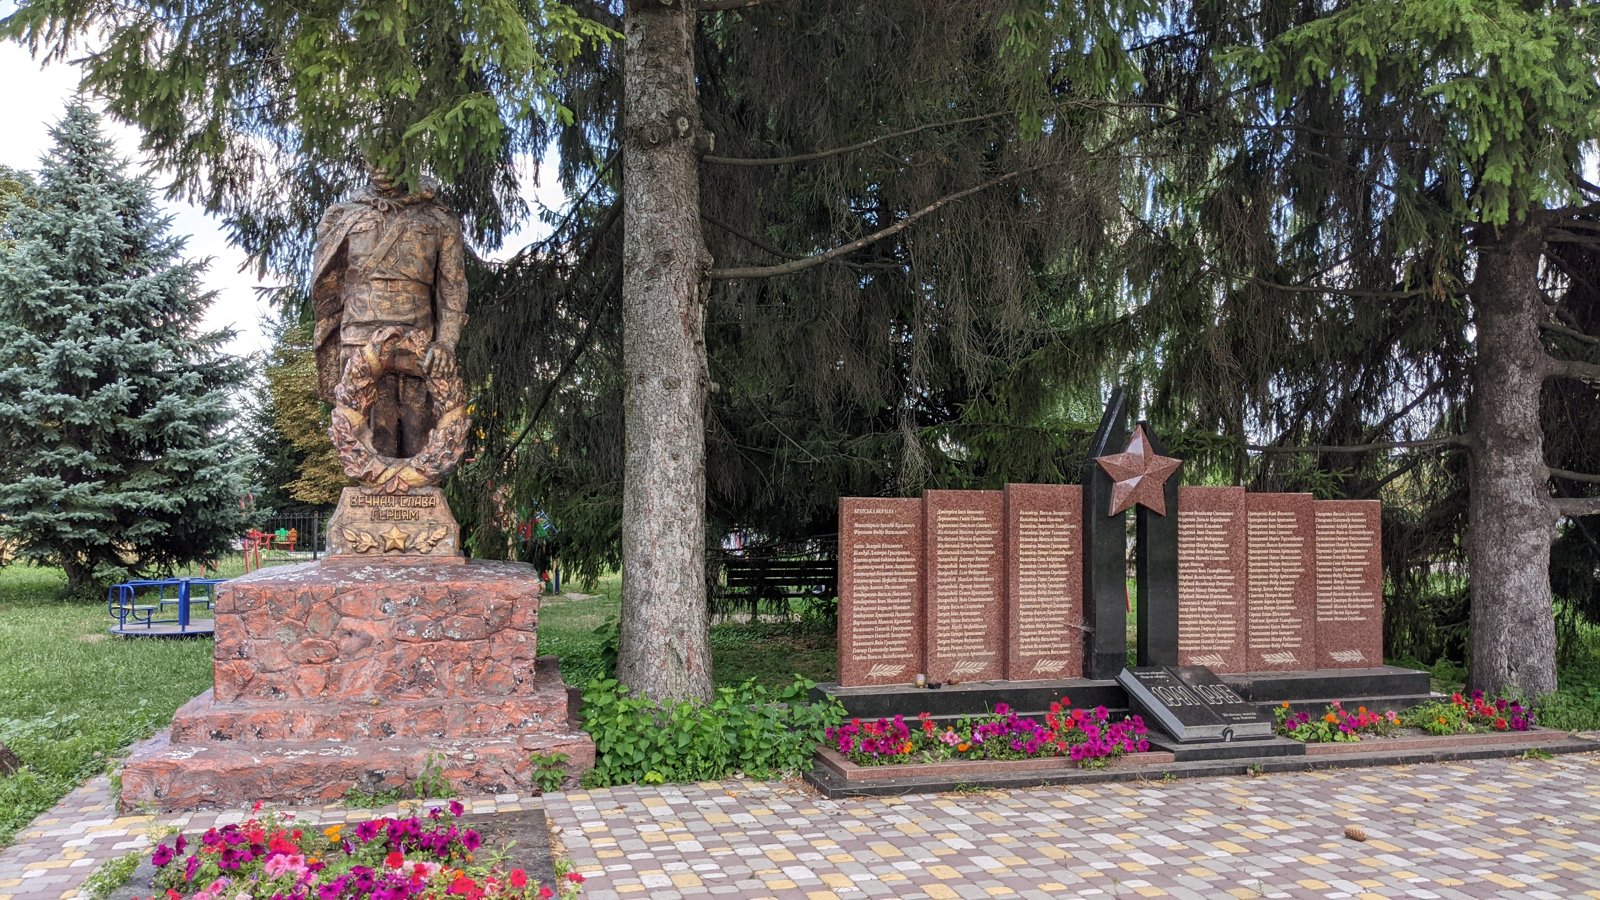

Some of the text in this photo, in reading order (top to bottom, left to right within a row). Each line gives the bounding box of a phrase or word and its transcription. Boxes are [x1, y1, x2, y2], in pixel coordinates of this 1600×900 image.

[350, 495, 436, 507] ВЕЧНАЯ СЛАВА
[371, 509, 419, 520] ГЕРОЯМ
[1151, 684, 1244, 707] 1941 1945
